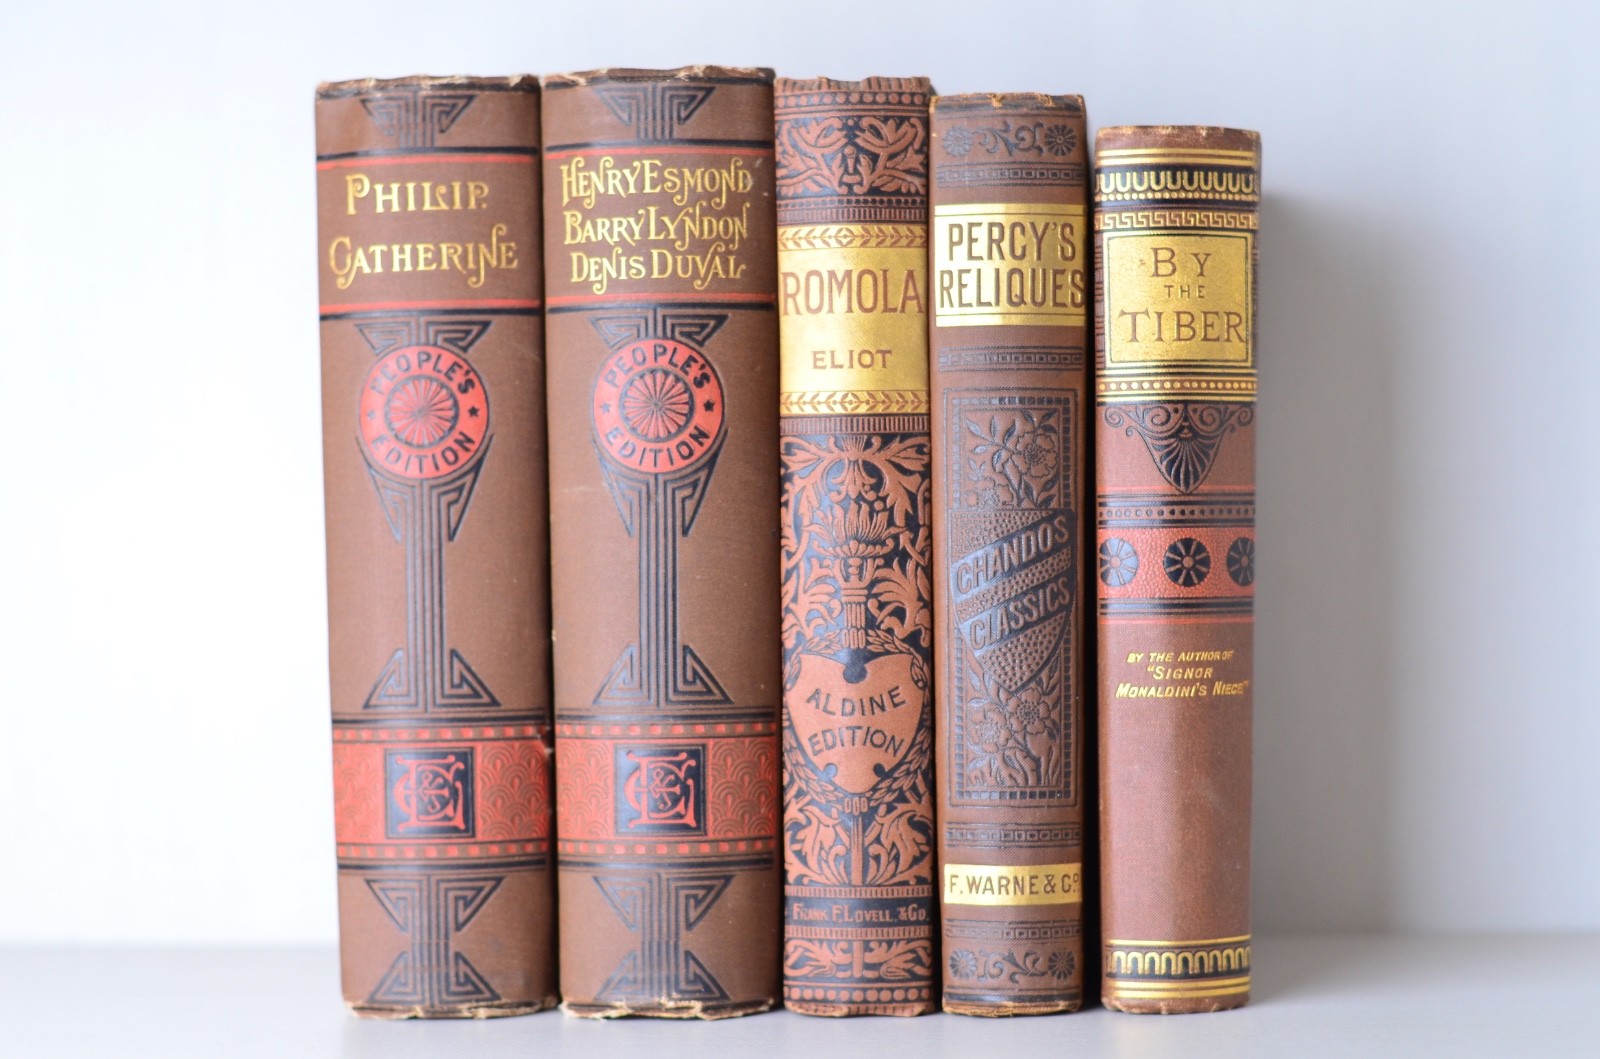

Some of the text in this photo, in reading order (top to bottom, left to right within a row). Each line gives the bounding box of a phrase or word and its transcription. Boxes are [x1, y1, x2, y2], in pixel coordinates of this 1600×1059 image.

[560, 156, 753, 210] HENRY ESMOND
[563, 200, 750, 251] BARRY LYNDON
[948, 221, 1076, 262] PERCY'S
[329, 224, 519, 290] CATHERINE
[570, 242, 747, 295] DENIS DUVAL
[1150, 246, 1213, 278] BY
[780, 268, 925, 317] ROMOLA
[939, 267, 1085, 309] RELIQUES
[1163, 284, 1205, 299] THE
[1117, 308, 1247, 343] TIBER
[604, 343, 711, 389] PEOPLE'S
[812, 349, 893, 370] ELIOT
[371, 430, 476, 474] EDITION
[605, 425, 711, 468] EDITION
[956, 515, 1070, 595] CHANDOS
[969, 576, 1070, 651] CLASSICS
[1127, 650, 1234, 663] BY THE AUTHOR OF
[806, 685, 907, 717] ALDINE
[808, 726, 905, 757] EDITION
[966, 874, 1039, 895] WARNE
[1043, 874, 1056, 894] &
